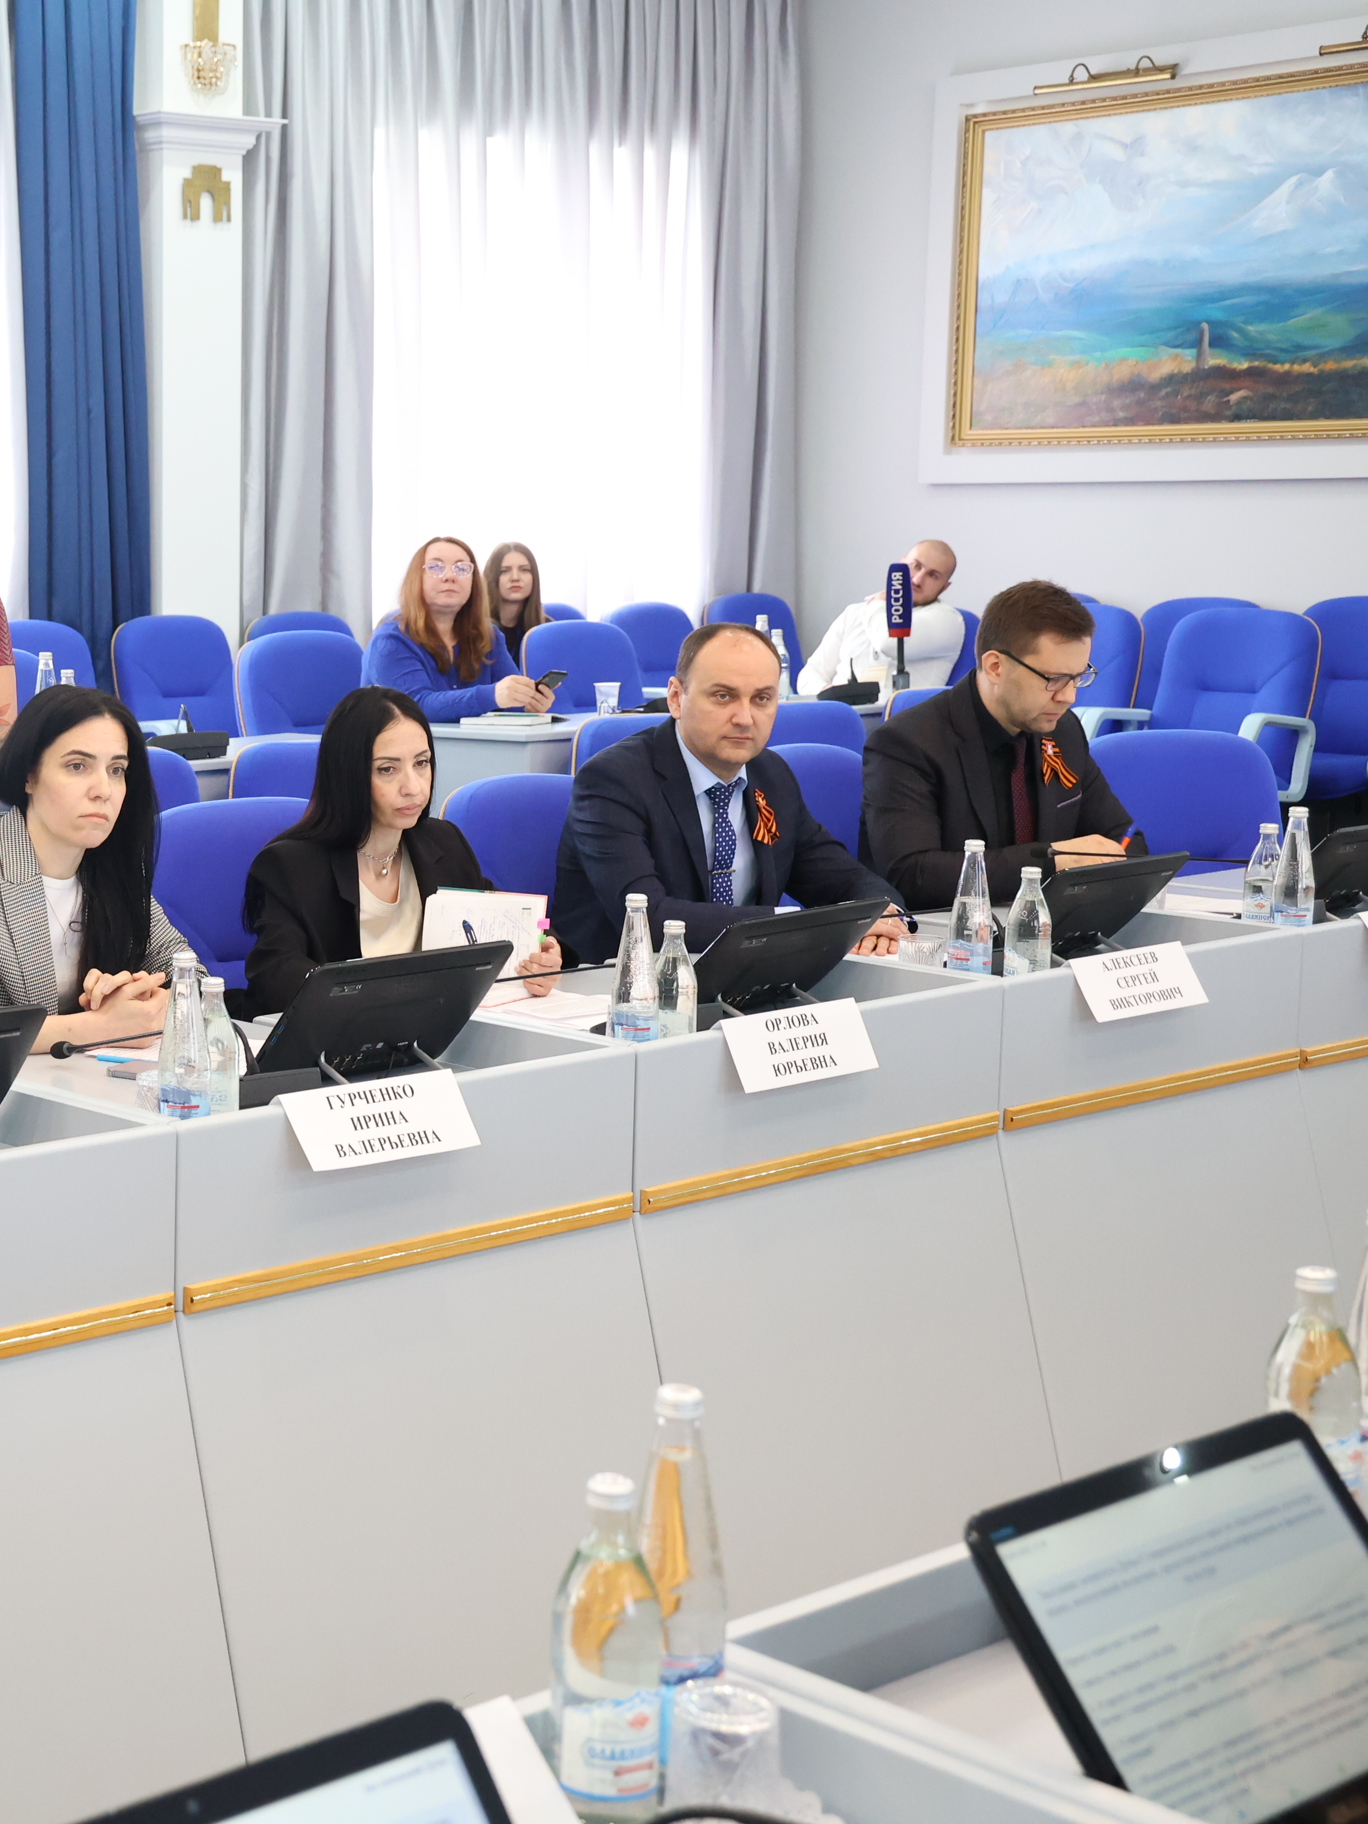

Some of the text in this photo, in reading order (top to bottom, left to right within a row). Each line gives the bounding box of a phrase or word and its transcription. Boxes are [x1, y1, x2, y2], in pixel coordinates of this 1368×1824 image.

[891, 572, 903, 622] РОССИЯ
[1102, 951, 1158, 972] АЛЕКСЕЕВ
[1116, 968, 1160, 990] СЕРГЕЙ
[1108, 986, 1184, 1011] ВИКТОРОВИЧ
[765, 1012, 819, 1032] ОРЛОВА
[767, 1032, 829, 1055] ВАЛЕРИЯ
[772, 1054, 838, 1077] ЮРЬЕВНА
[325, 1083, 415, 1111] ГУРЧЕНКО
[350, 1110, 409, 1132] ИРИНА
[334, 1129, 442, 1158] ВАЛЕРЬЕВНА
